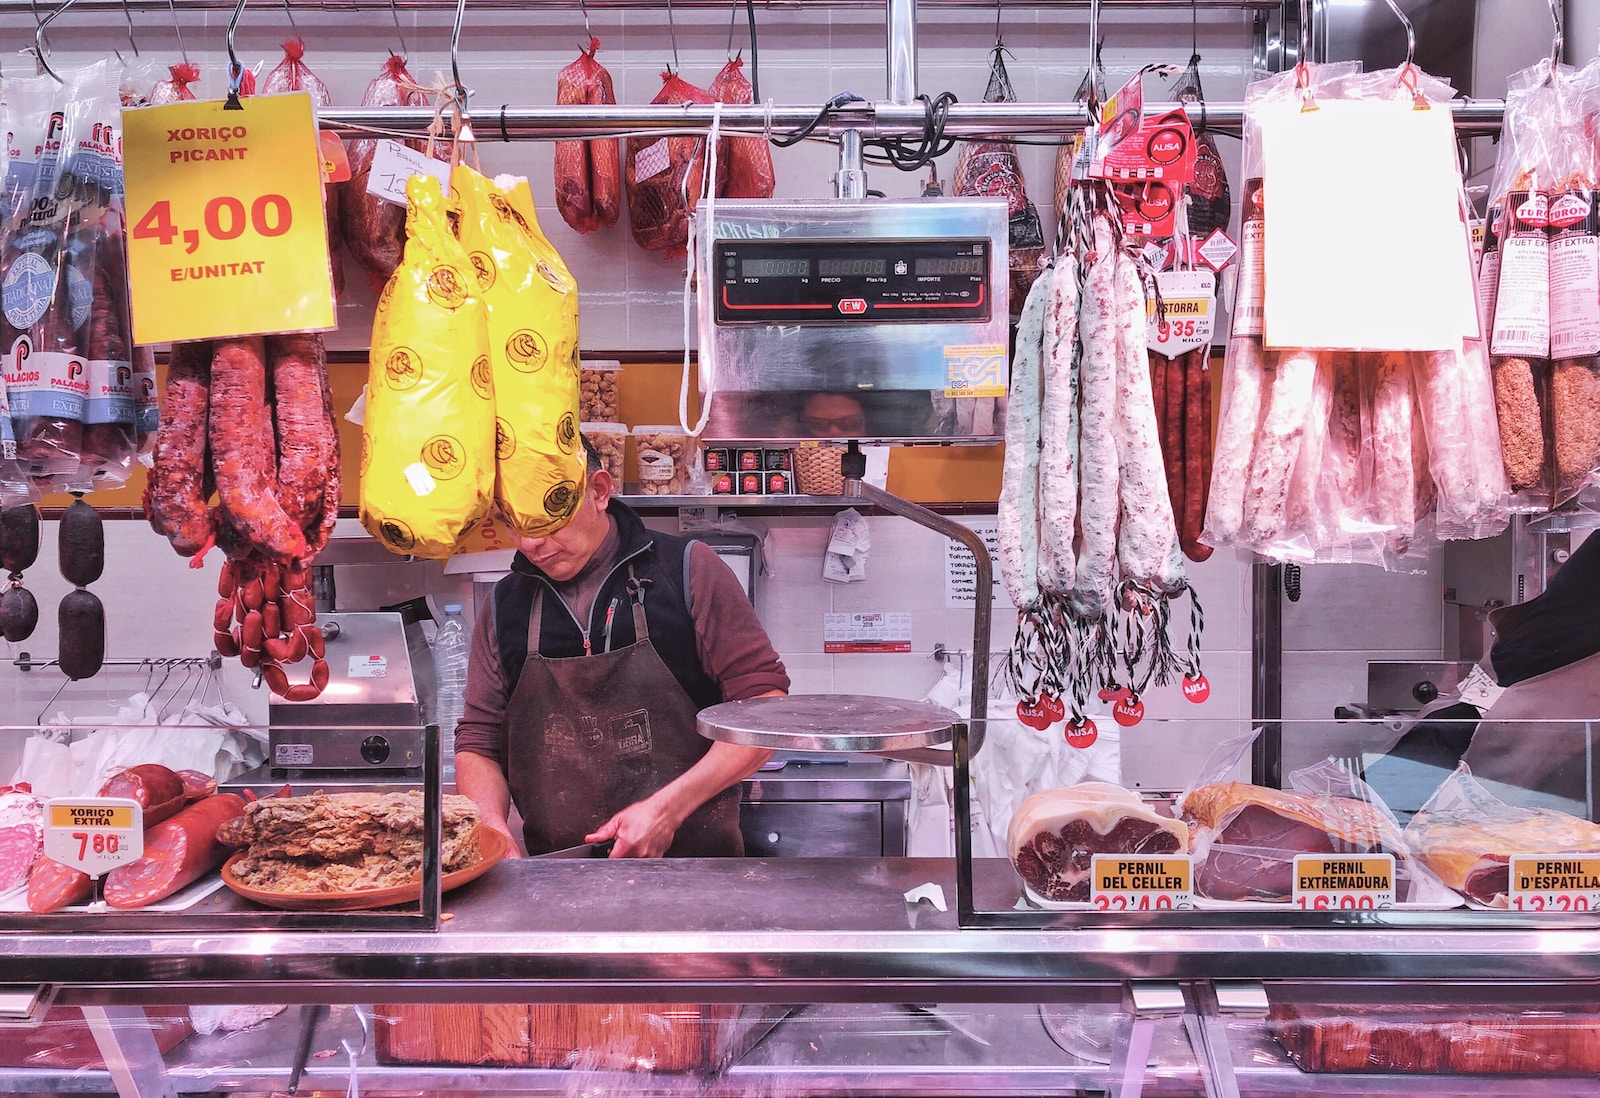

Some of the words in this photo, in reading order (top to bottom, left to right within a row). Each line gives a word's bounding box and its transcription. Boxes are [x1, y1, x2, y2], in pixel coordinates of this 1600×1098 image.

[167, 126, 247, 143] XORIÇO
[1153, 143, 1180, 152] AUSA
[170, 148, 248, 164] PICANT
[133, 194, 293, 255] 4,00
[1565, 238, 1594, 246] EXTRA
[170, 261, 265, 282] E/UNITAT
[844, 302, 862, 310] FW
[1185, 684, 1207, 694] AUSA
[1018, 708, 1044, 718] AUSA
[1117, 705, 1142, 718] AUSA
[1068, 728, 1094, 738] AUSA
[70, 808, 114, 818] XORIÇO
[74, 818, 110, 826] EXTRA
[1118, 862, 1167, 875] PERNIL
[1323, 862, 1365, 875] PERNIL
[1537, 862, 1584, 874] PERNIL
[1103, 876, 1128, 889] DEL
[1132, 876, 1182, 889] CELLER
[1300, 876, 1389, 889] EXTREMADURA
[1521, 876, 1600, 889] D'ESPATLLA
